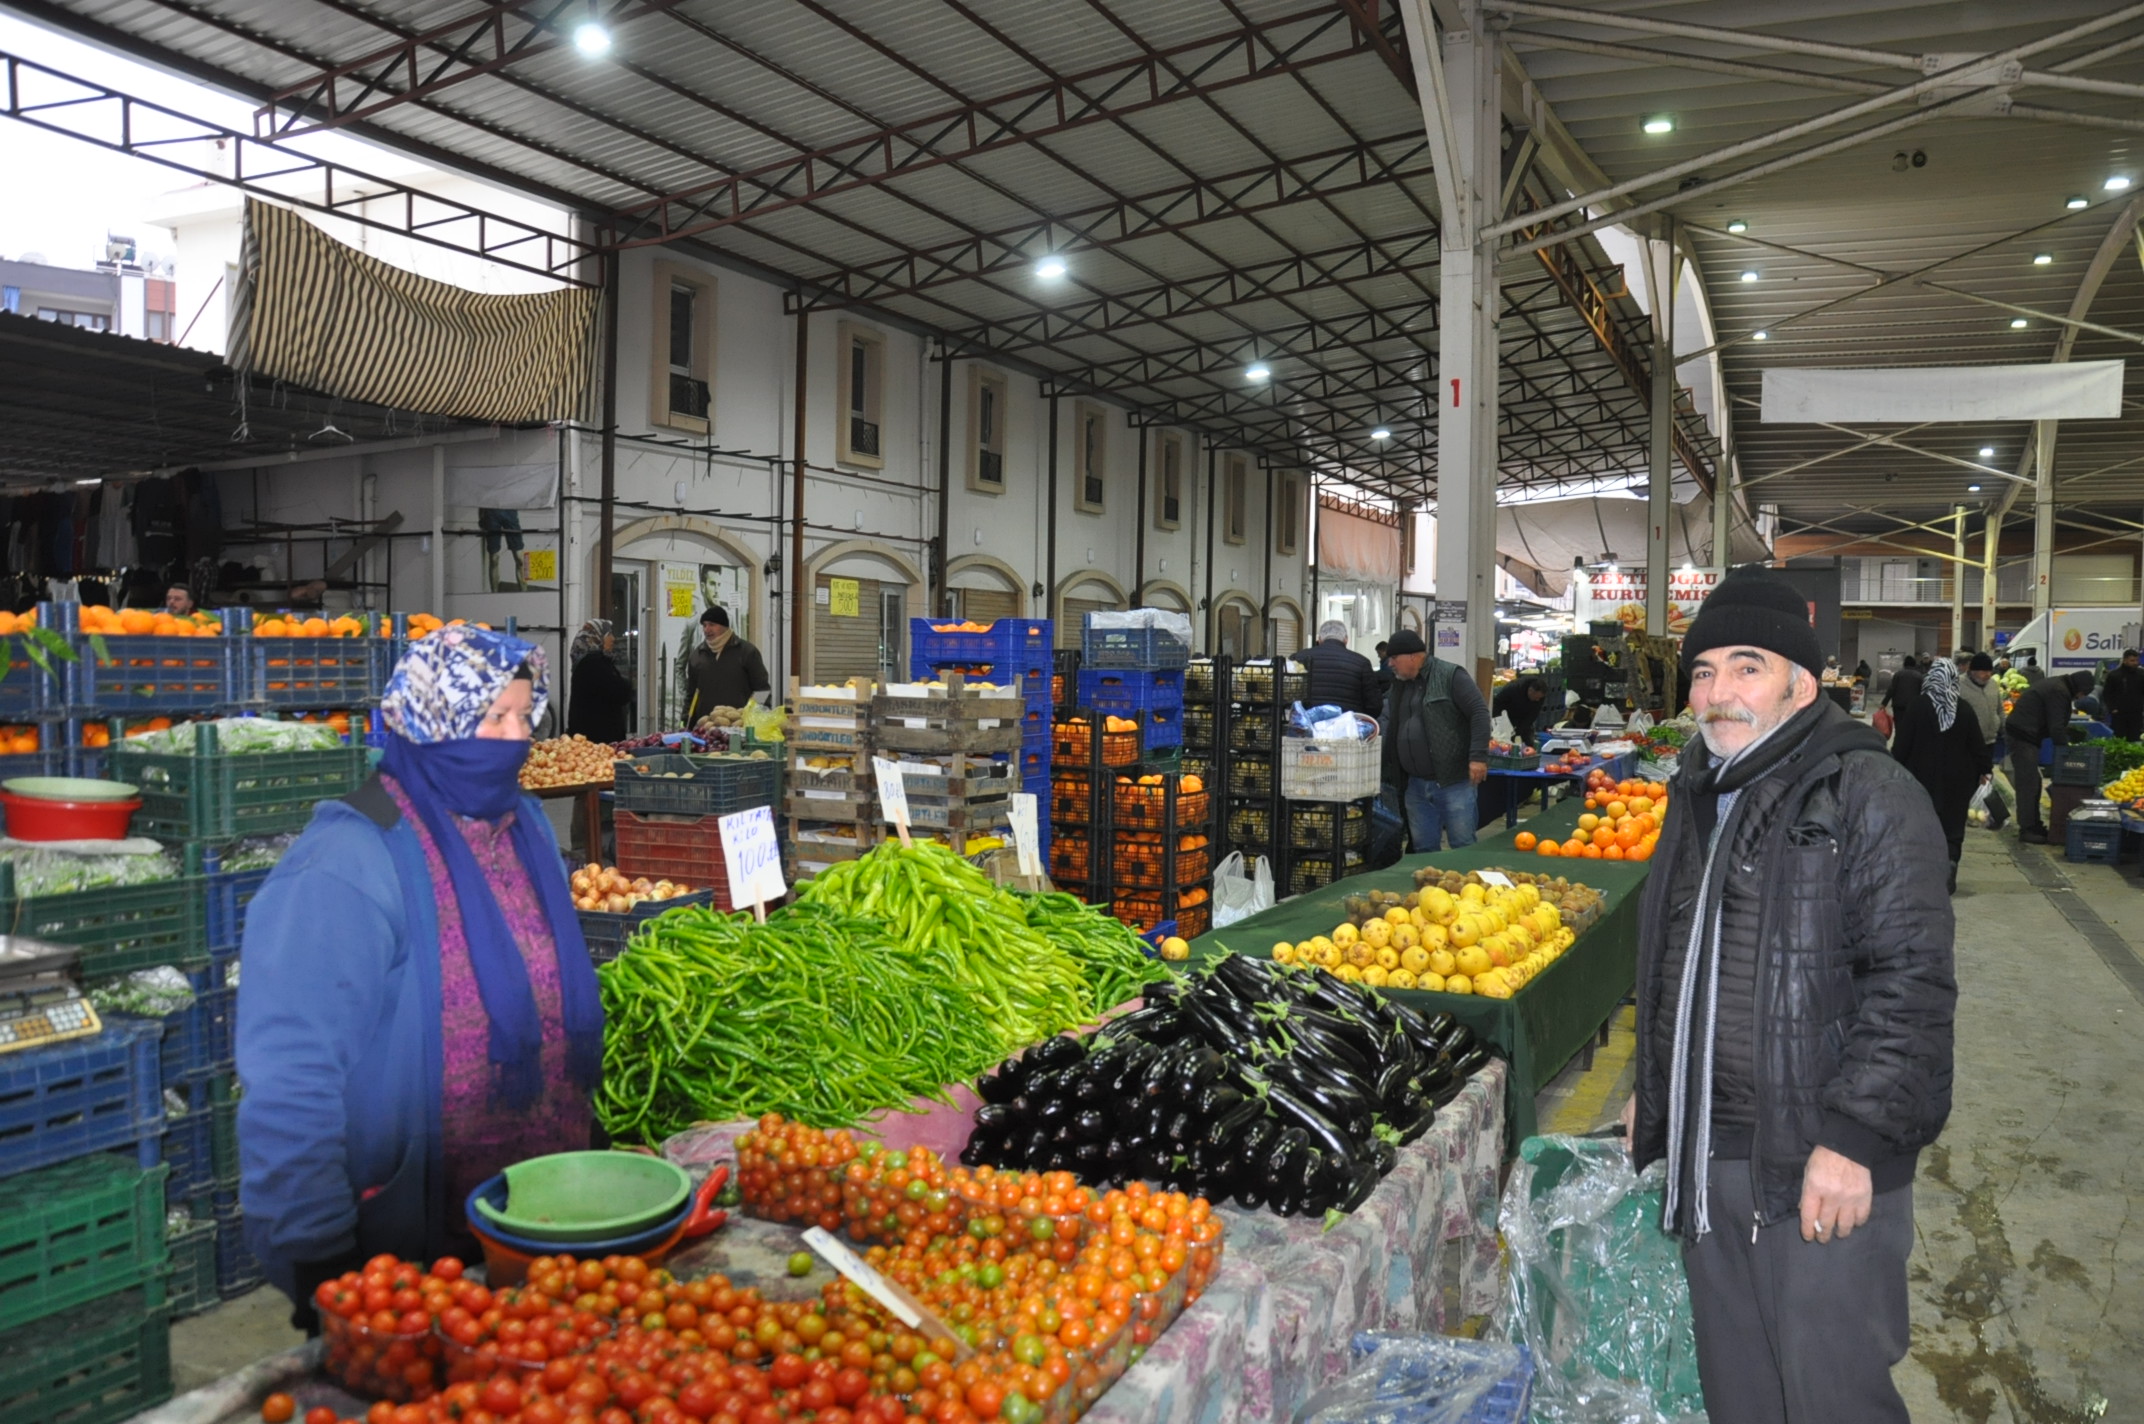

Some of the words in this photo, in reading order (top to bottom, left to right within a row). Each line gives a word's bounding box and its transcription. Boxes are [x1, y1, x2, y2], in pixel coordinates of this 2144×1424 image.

[1450, 378, 1460, 408] 1
[1655, 526, 1661, 541] 1
[2040, 575, 2047, 585] 2
